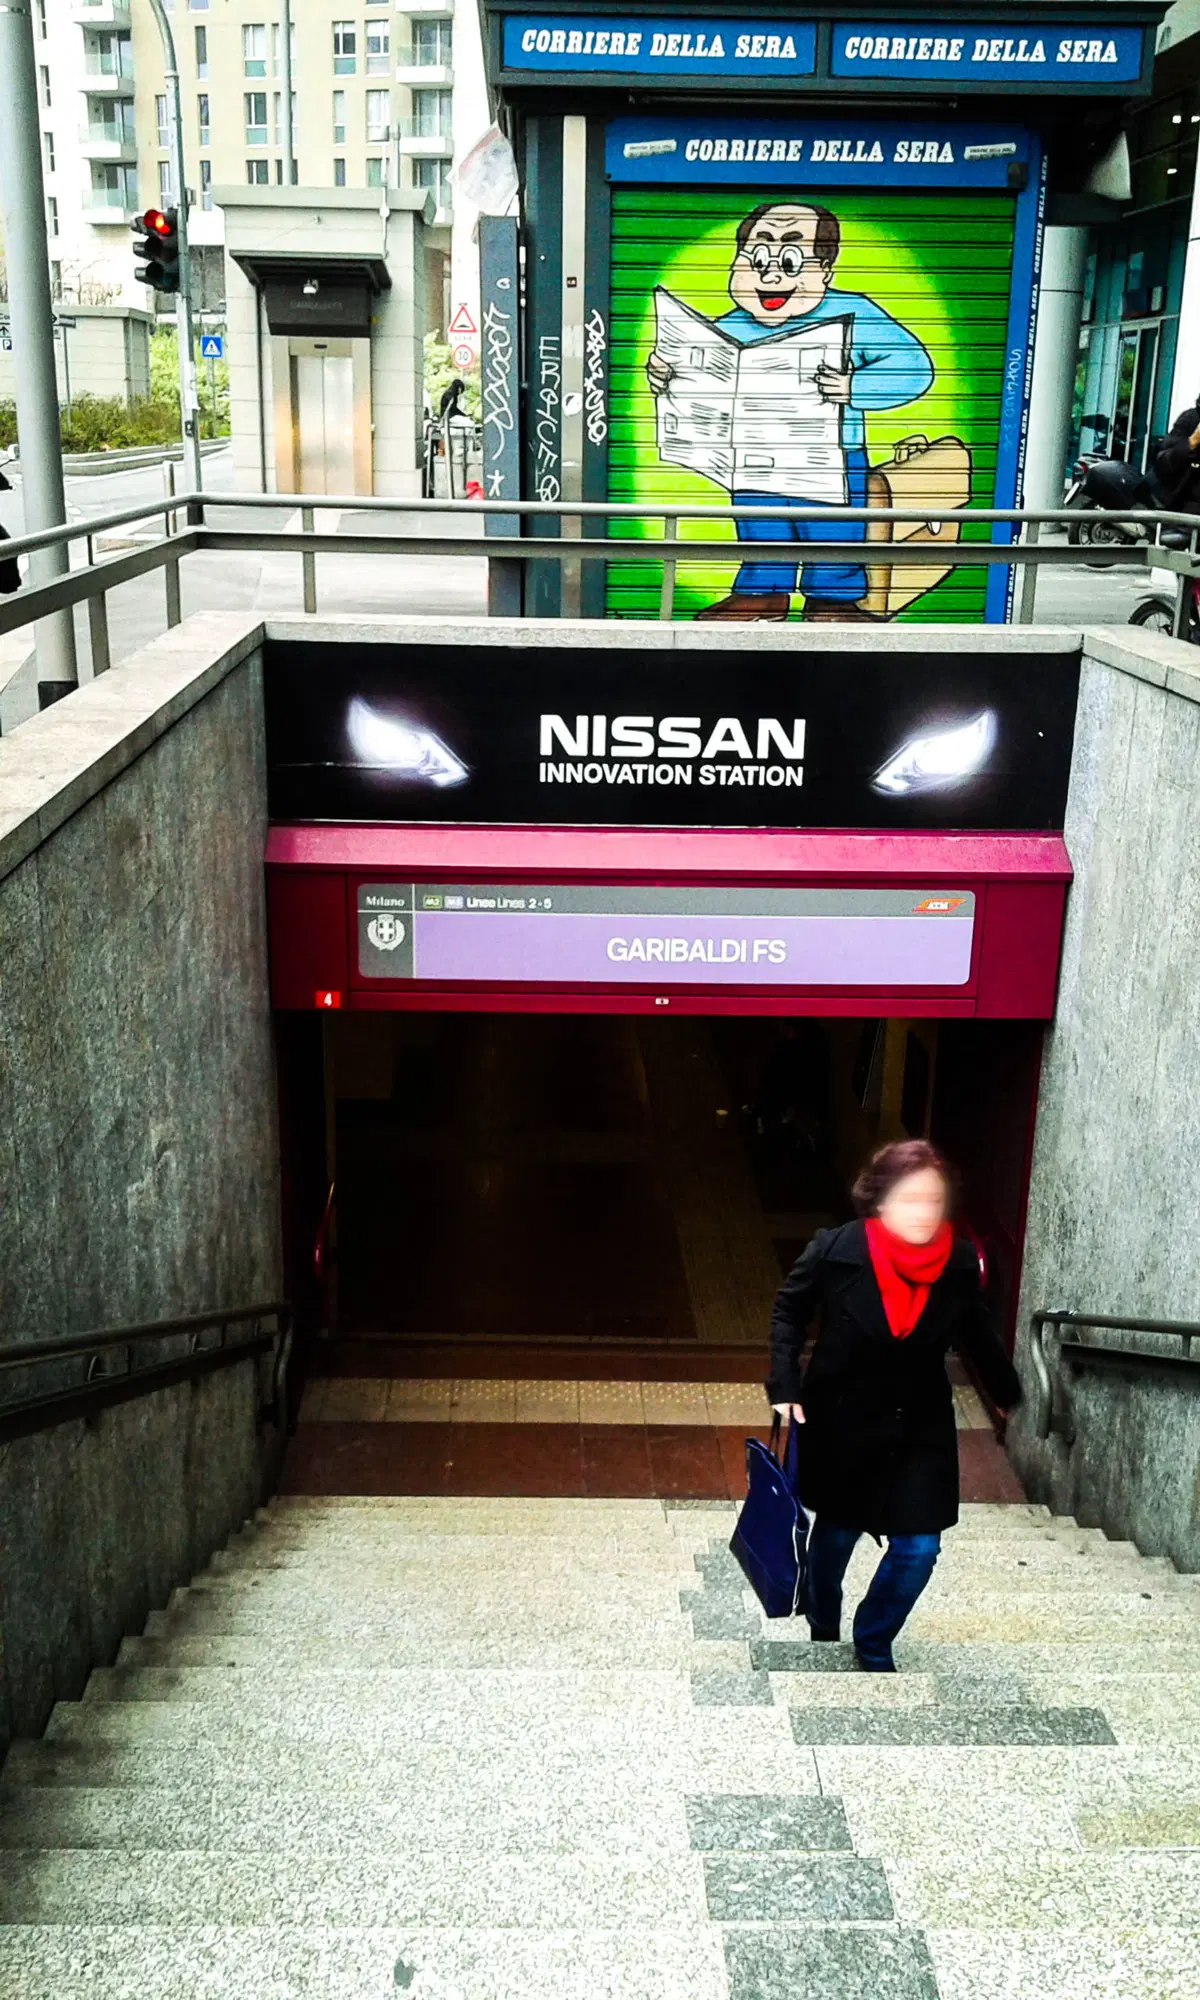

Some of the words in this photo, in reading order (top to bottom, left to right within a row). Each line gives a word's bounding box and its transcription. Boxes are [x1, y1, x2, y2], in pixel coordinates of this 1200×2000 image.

[521, 29, 642, 56] CORRIERE
[650, 33, 725, 58] DELLA
[734, 35, 797, 59] SERA
[845, 36, 964, 61] CORRIERE
[971, 39, 1047, 62] DELLA
[1056, 40, 1118, 63] SERA
[685, 139, 803, 162] CORRIERE
[810, 140, 884, 162] DELLA
[893, 141, 954, 164] SERA
[1038, 186, 1046, 219] DELLA
[1034, 222, 1043, 273] CORRIERE
[1031, 284, 1039, 310] SERA
[1028, 314, 1036, 346] DELLA
[1024, 349, 1033, 399] CORRIERE
[1021, 408, 1029, 434] SERA
[1018, 437, 1026, 469] DELLA
[539, 714, 806, 760] NISSAN
[539, 762, 692, 785] INNOVATION
[698, 765, 804, 787] STATION
[366, 896, 405, 907] Milano
[927, 901, 949, 910] ATM
[607, 937, 747, 963] GARIBALDI
[753, 938, 788, 964] FS
[324, 992, 332, 1006] 4
